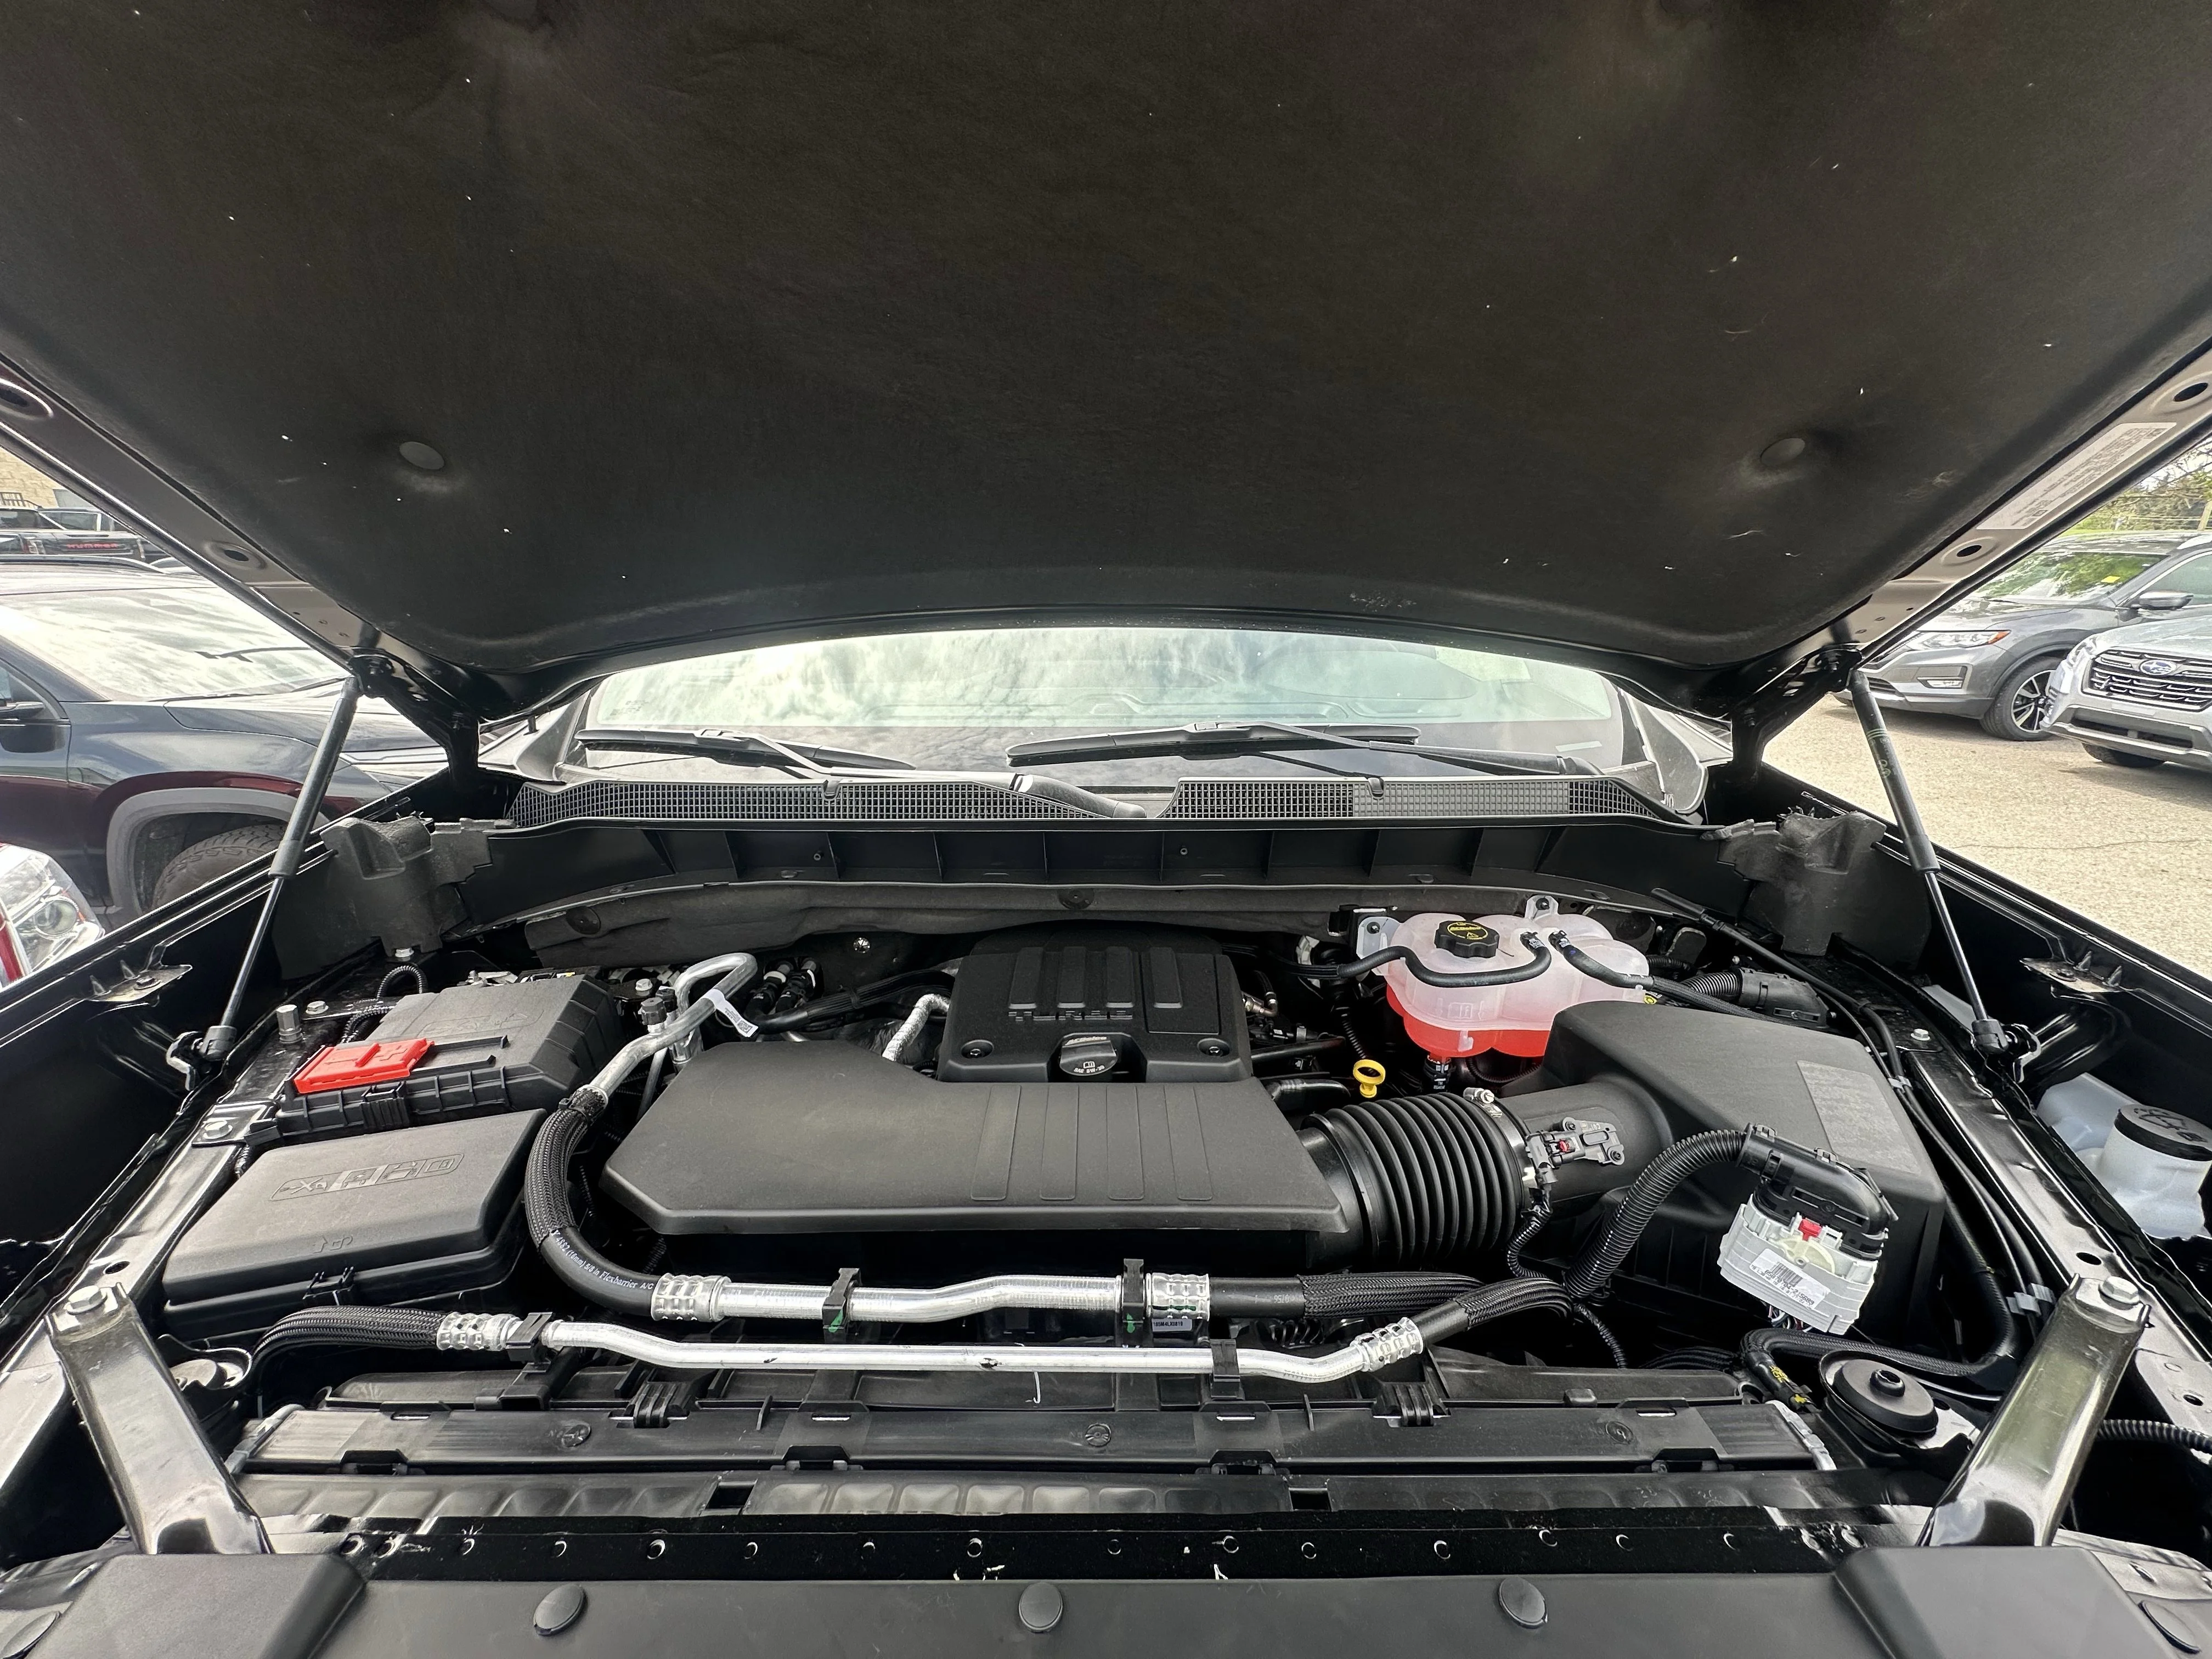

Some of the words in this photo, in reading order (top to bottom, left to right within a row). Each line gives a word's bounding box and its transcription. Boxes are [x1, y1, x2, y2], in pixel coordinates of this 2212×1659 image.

[566, 1250, 586, 1268] (16mm)
[584, 1263, 595, 1272] 5/8
[599, 1271, 638, 1289] Flexbarrier
